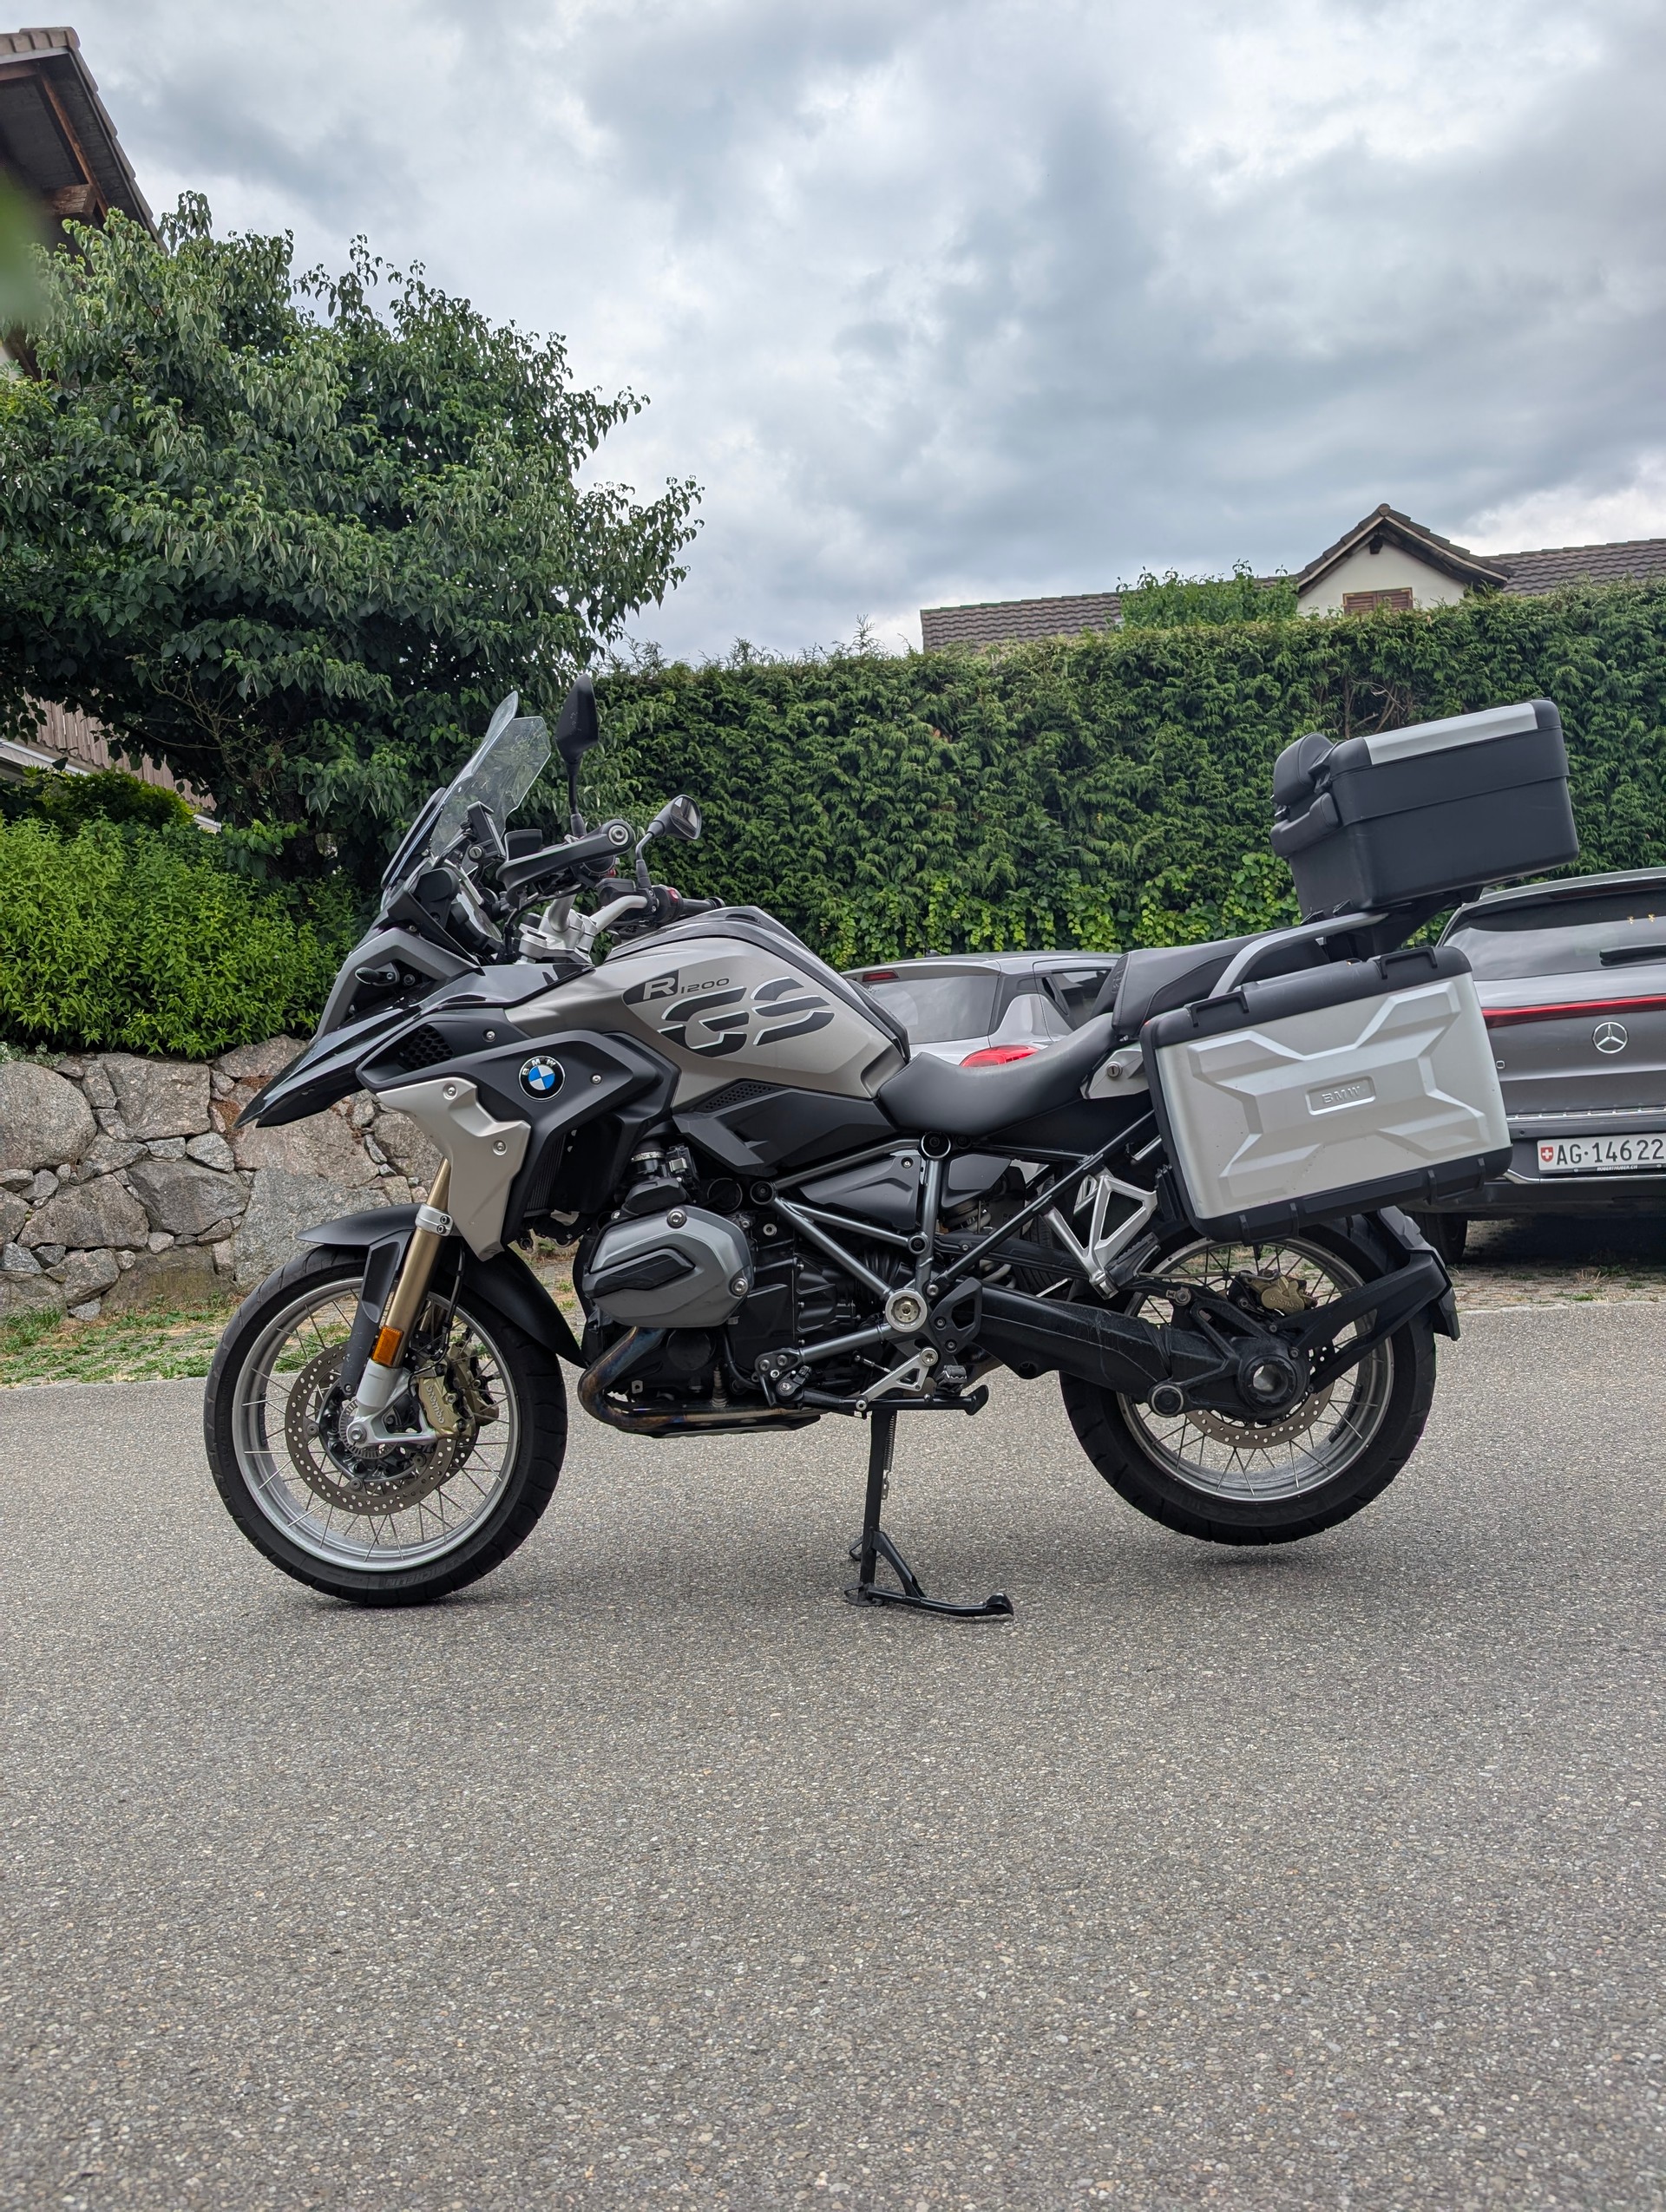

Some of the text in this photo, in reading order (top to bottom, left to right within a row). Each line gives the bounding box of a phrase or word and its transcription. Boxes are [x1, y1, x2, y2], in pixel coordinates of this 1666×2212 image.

[657, 976, 835, 1058] GS
[521, 1058, 556, 1076] BMW
[1322, 1085, 1360, 1103] BMW
[426, 1384, 444, 1423] brembo
